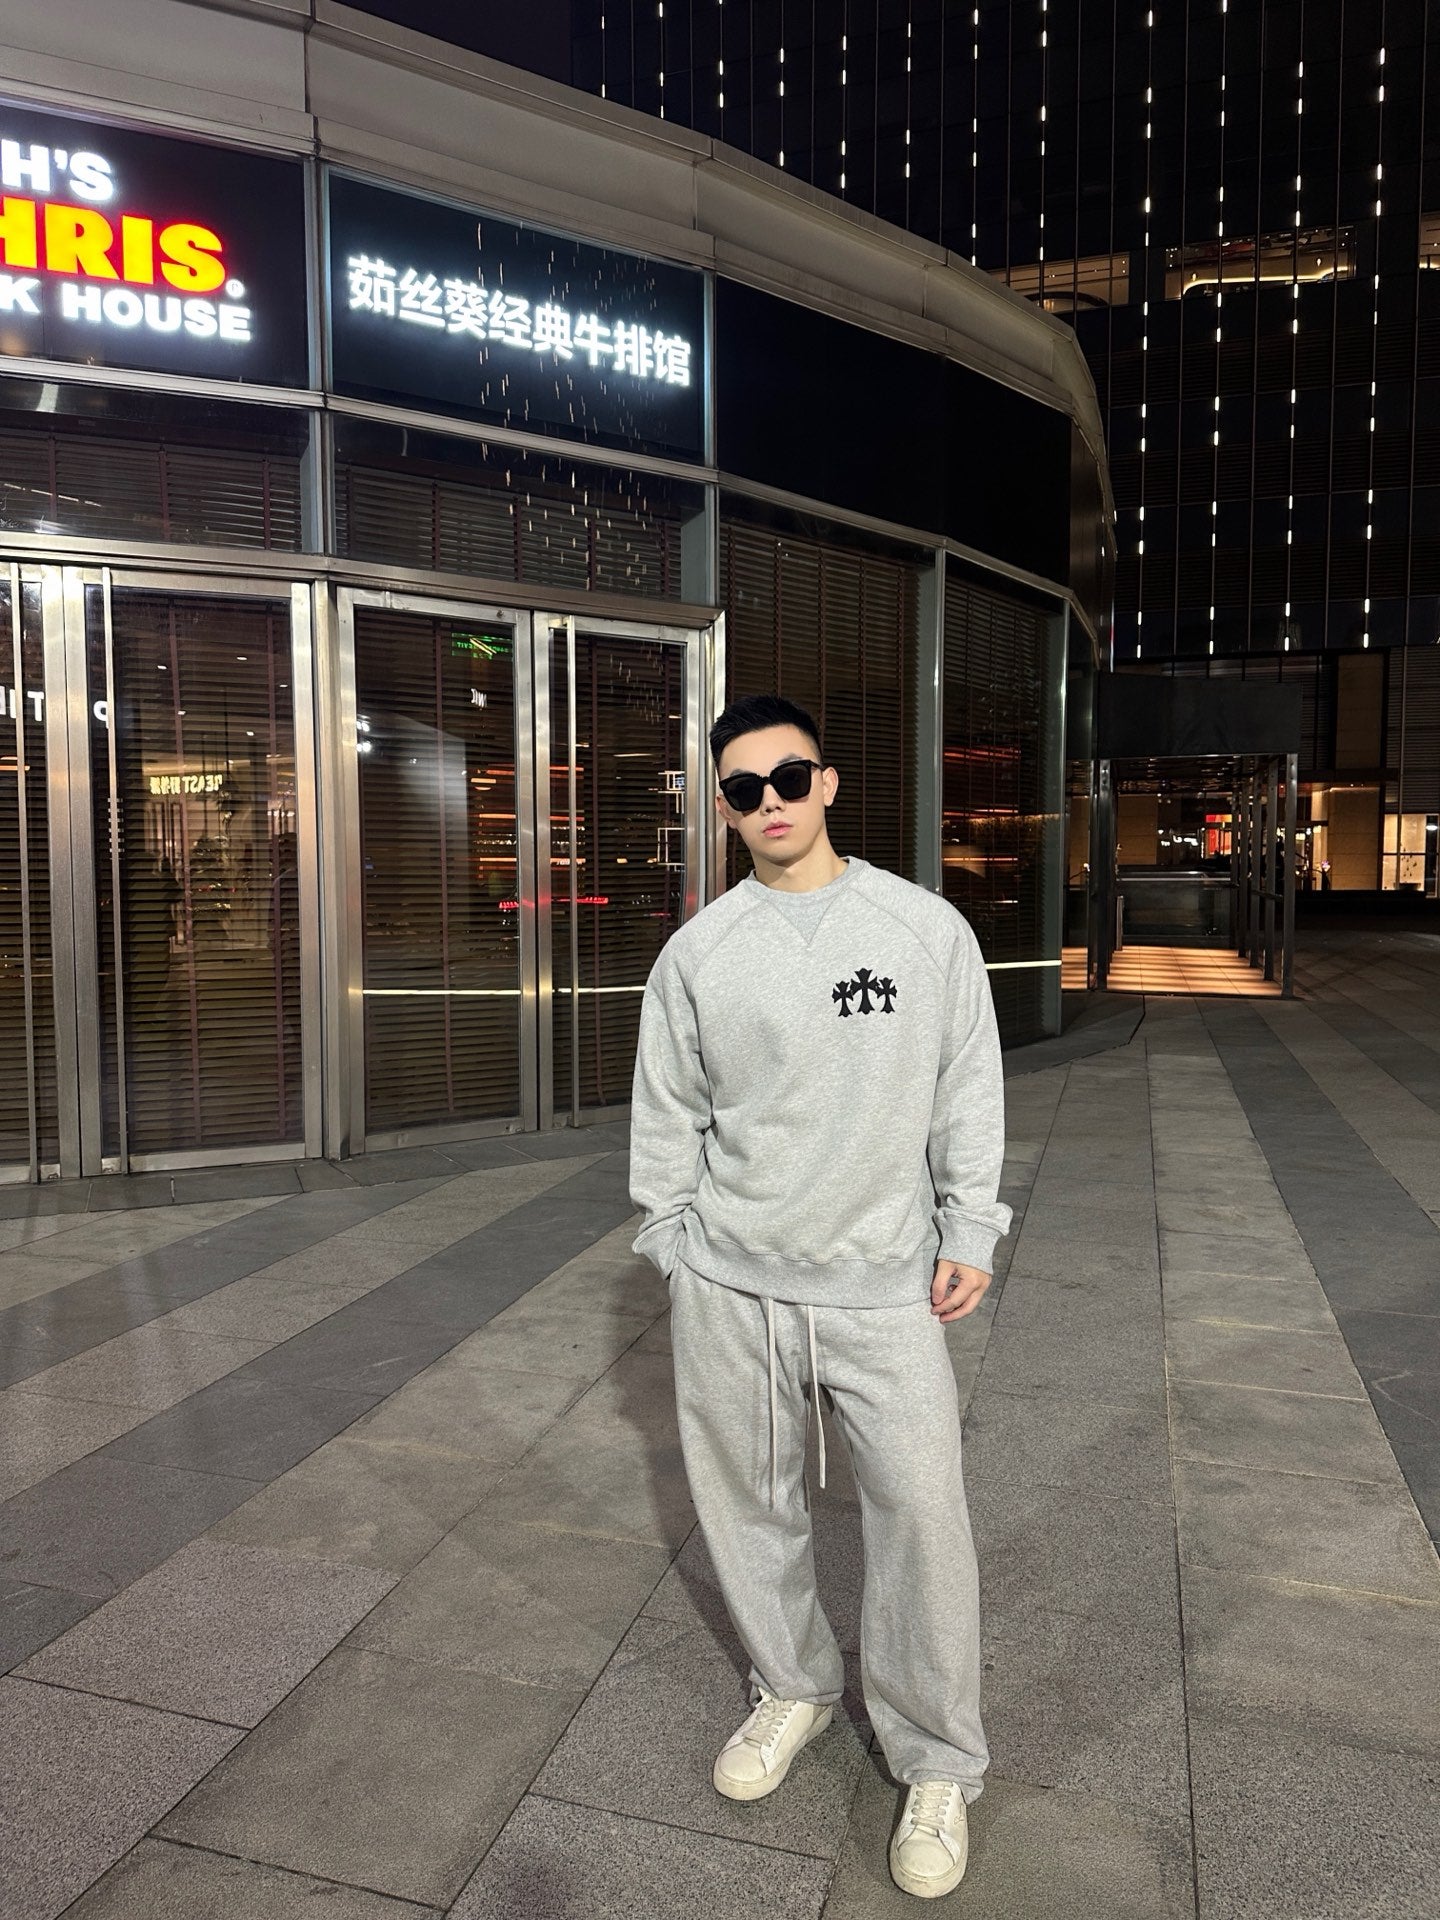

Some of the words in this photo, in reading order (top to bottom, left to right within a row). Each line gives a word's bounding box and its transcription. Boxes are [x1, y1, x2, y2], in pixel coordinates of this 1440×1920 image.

[1, 138, 115, 201] H'S
[61, 281, 251, 342] HOUSE
[347, 254, 692, 387] 茹丝葵经典牛排馆
